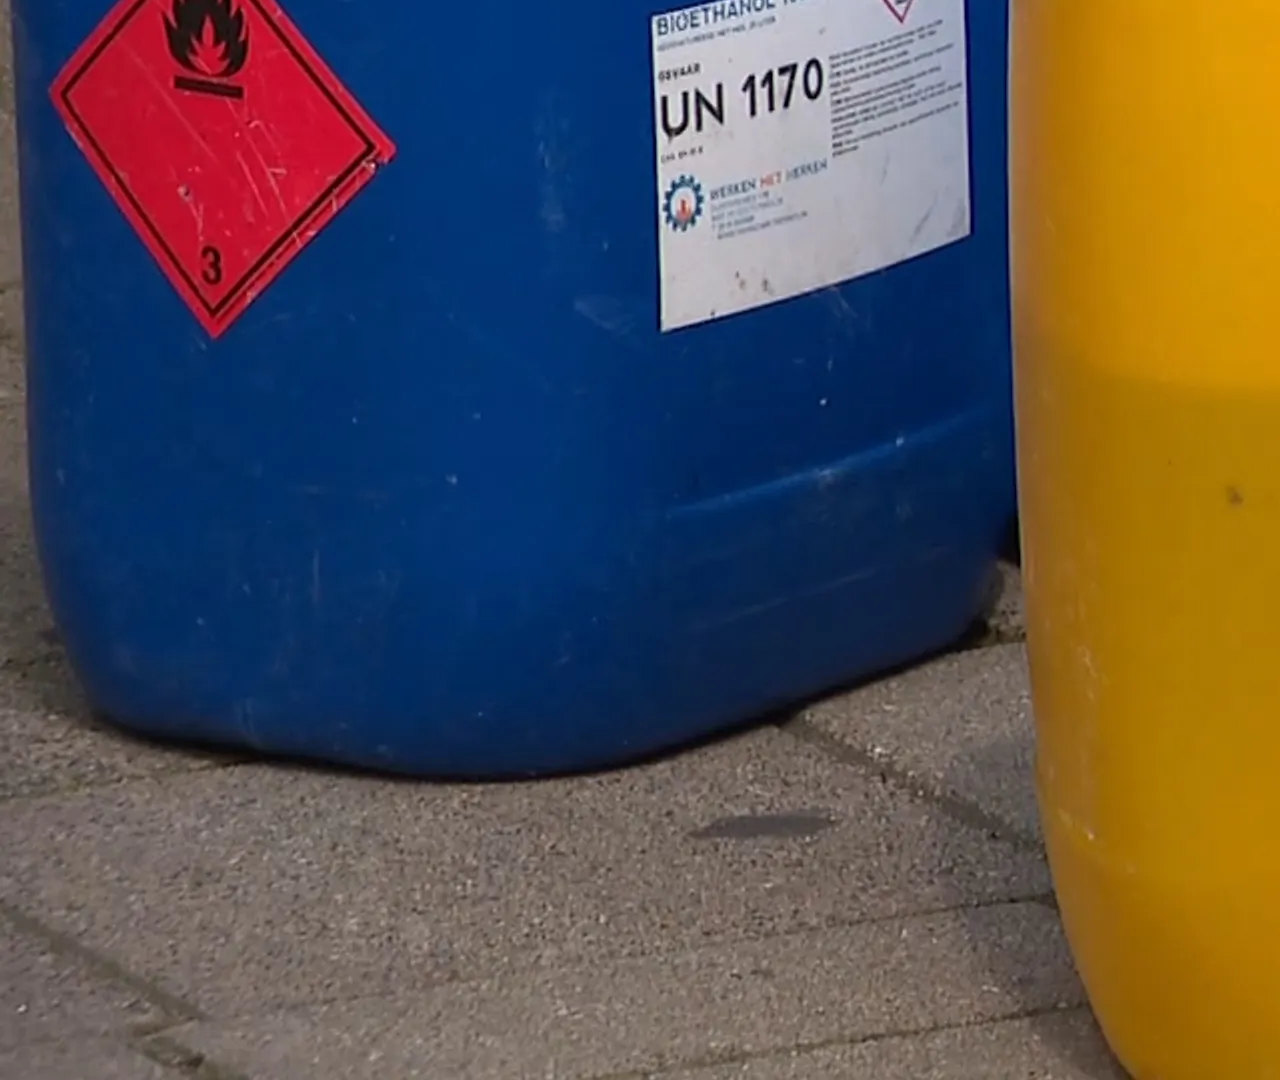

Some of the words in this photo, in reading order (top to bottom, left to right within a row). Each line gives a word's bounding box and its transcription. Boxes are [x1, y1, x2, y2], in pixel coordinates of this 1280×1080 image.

[660, 81, 725, 140] UN
[741, 57, 824, 118] 1170
[202, 245, 223, 286] 3
